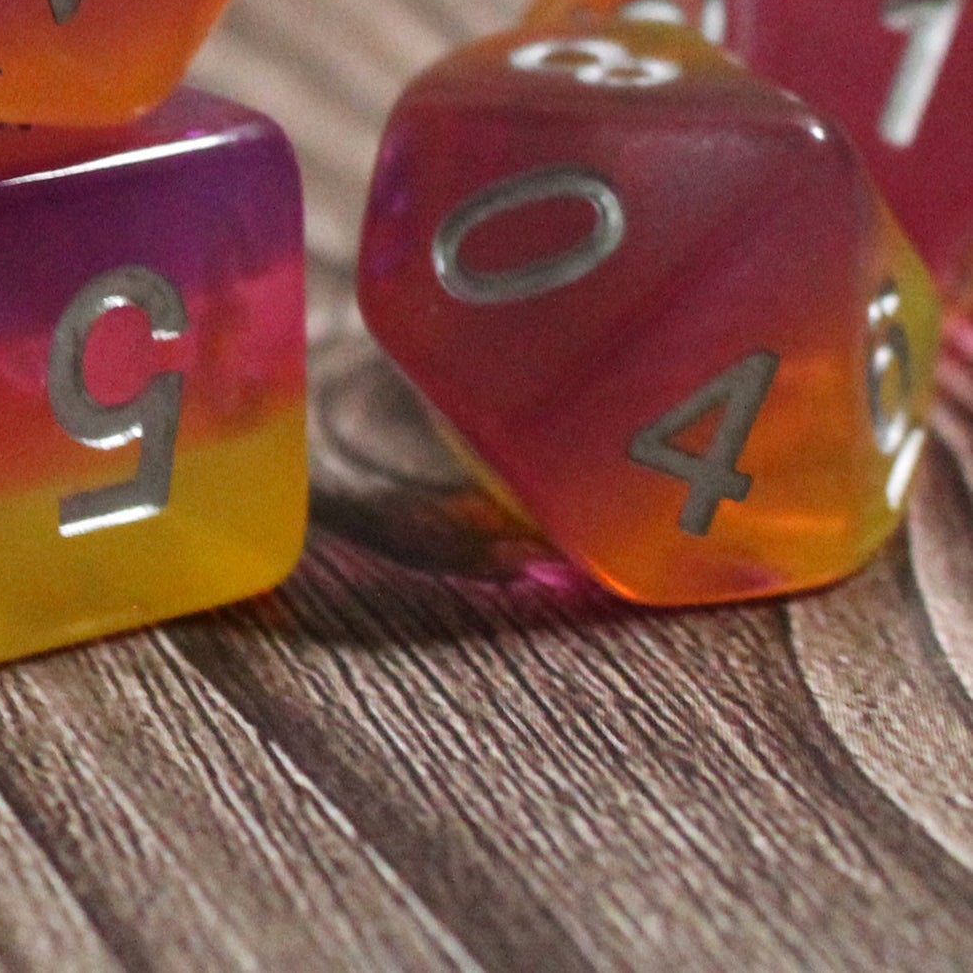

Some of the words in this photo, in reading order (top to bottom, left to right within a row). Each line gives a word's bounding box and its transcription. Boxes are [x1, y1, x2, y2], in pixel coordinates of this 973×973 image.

[431, 165, 623, 305] 0
[47, 263, 190, 538] 5
[629, 349, 779, 537] 4
